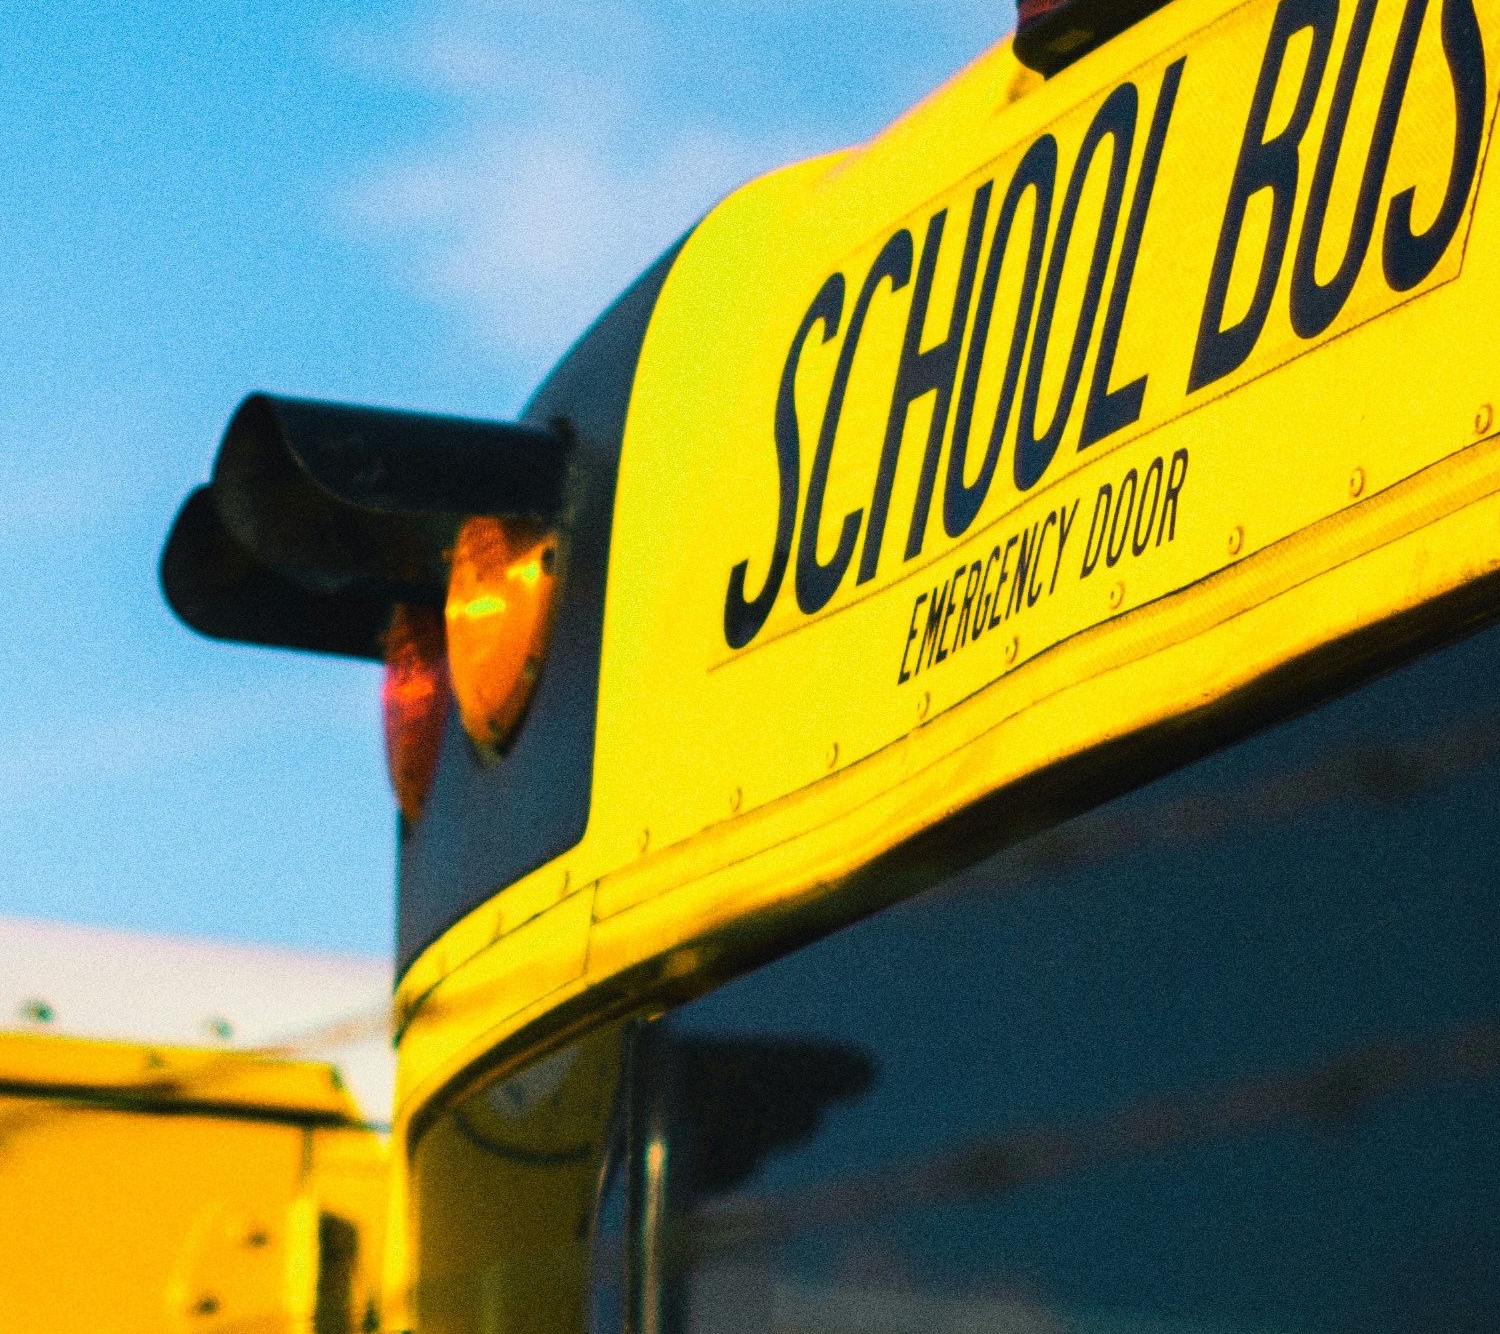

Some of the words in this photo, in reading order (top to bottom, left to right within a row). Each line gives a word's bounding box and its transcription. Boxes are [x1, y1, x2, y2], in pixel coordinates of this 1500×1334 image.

[723, 55, 1188, 650] SCHOOL
[897, 498, 1080, 685] EMERGENCY
[1079, 447, 1189, 579] DOOR
